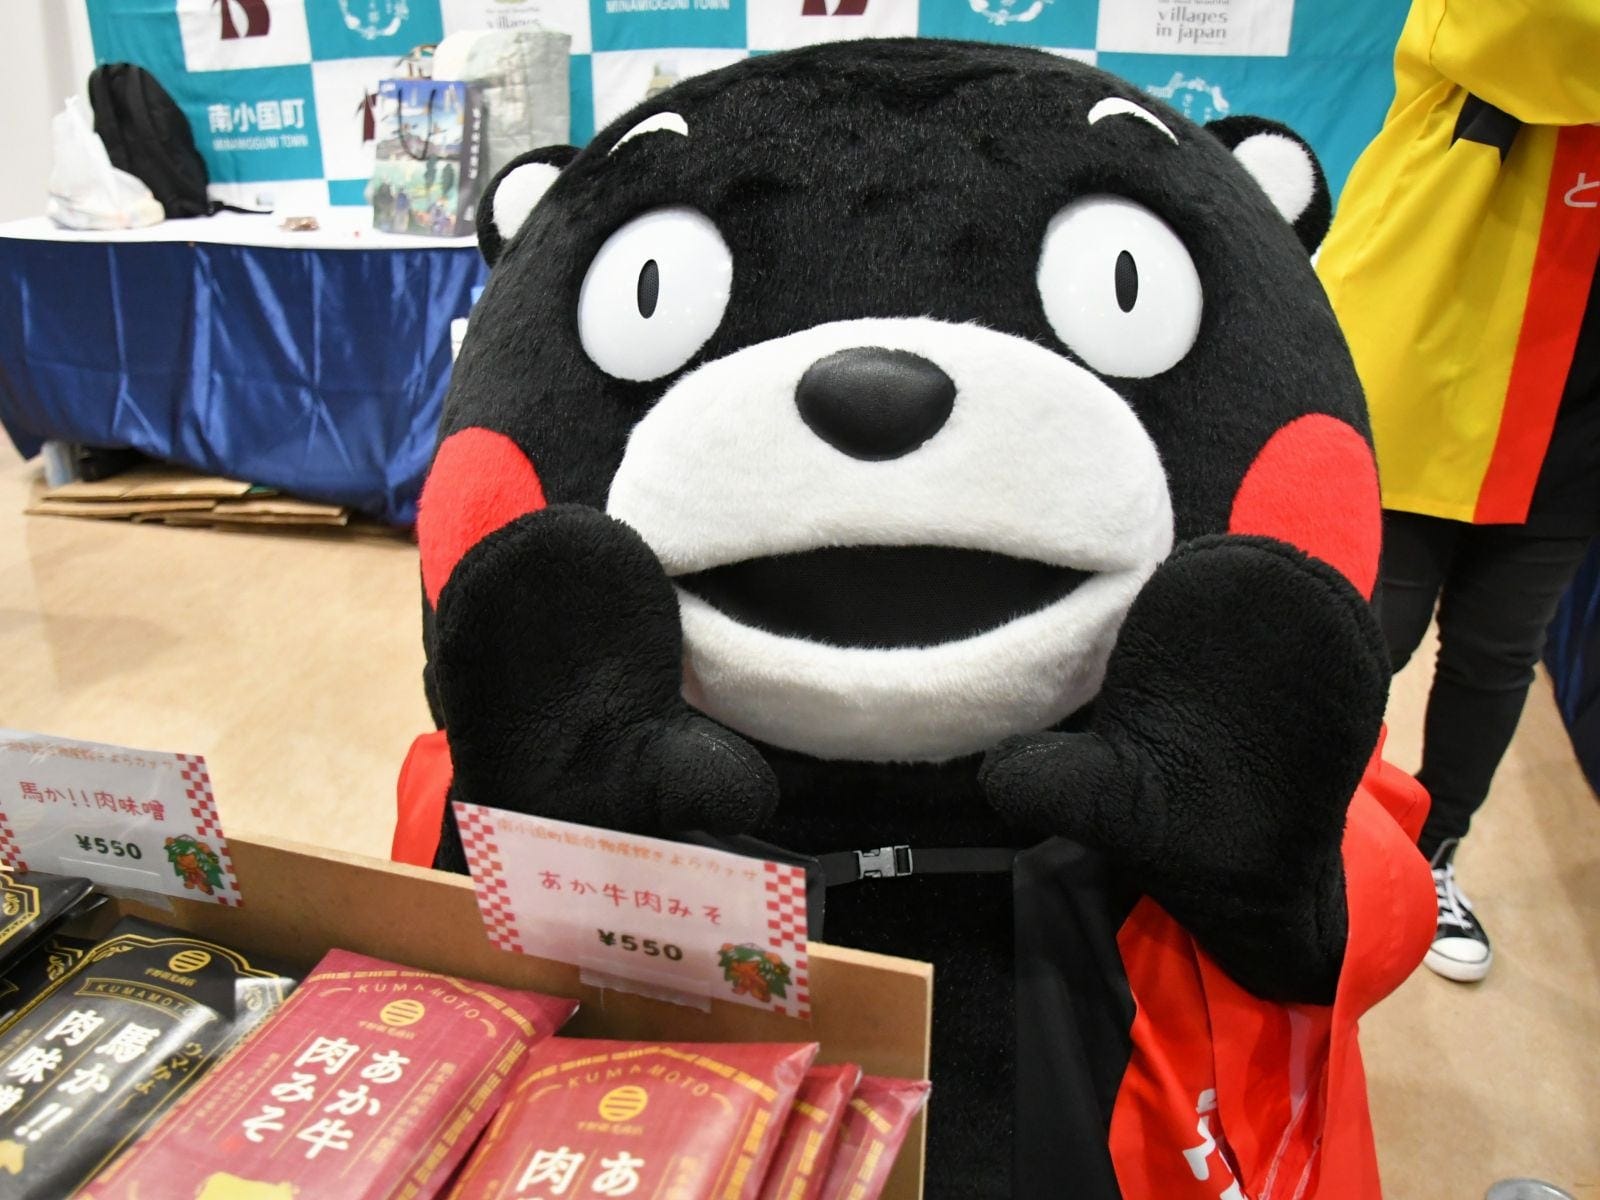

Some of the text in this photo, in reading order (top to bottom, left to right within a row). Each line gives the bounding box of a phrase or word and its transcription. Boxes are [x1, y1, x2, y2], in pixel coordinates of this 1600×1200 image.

[1158, 6, 1229, 24] villages
[1156, 23, 1227, 44] in japan
[207, 99, 305, 133] 南小国町
[75, 833, 142, 861] ¥550
[538, 871, 721, 926] あか牛肉みそ
[597, 928, 684, 962] ¥550
[95, 983, 195, 1019] KUMAMOTO
[357, 983, 480, 1019] KUMAMOTO
[242, 1036, 360, 1143] 肉みそ
[567, 1063, 709, 1097] KUMAMOTO
[296, 1050, 410, 1160] あか牛
